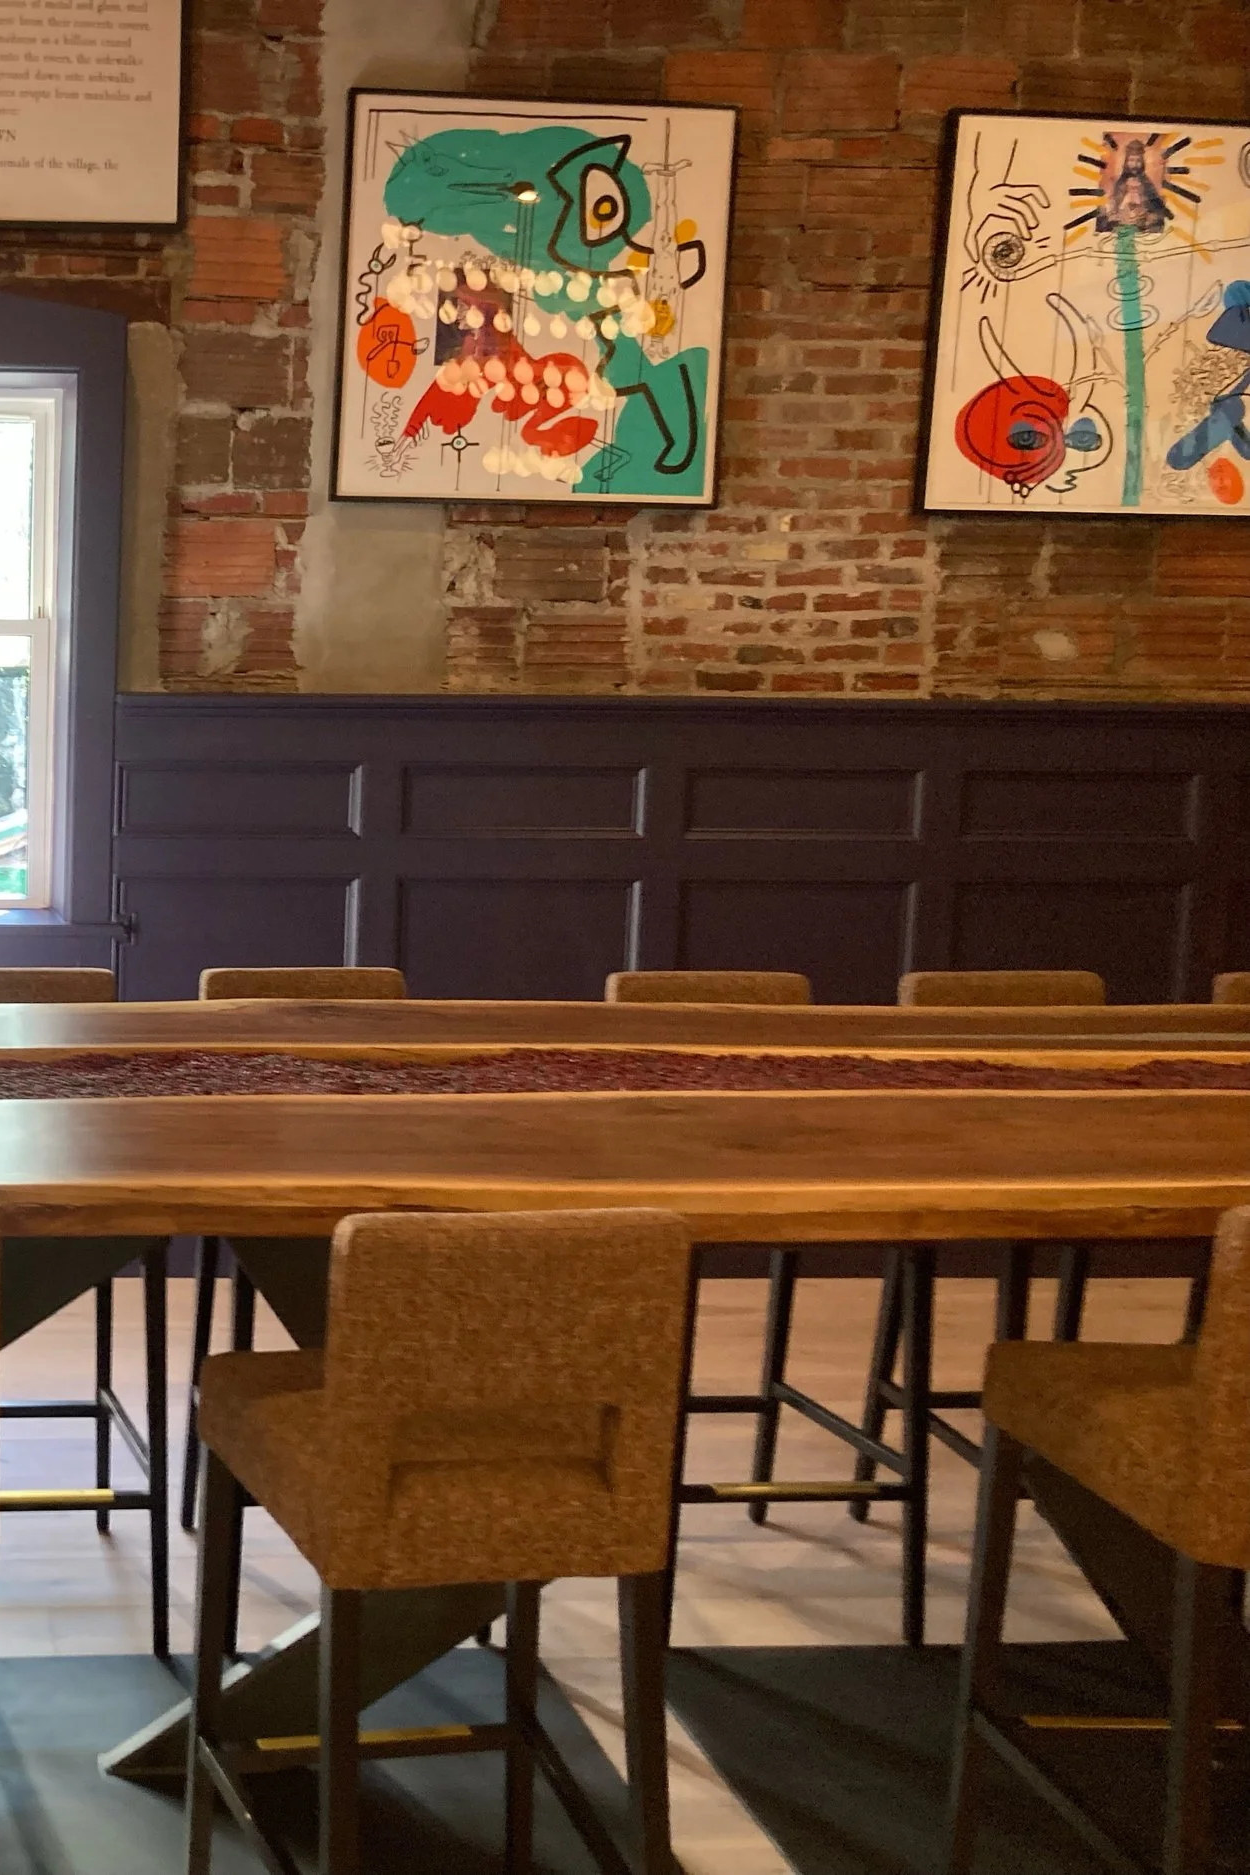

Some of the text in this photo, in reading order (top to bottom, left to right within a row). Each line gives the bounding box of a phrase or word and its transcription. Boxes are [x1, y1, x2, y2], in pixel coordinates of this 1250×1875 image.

[24, 51, 40, 62] the
[76, 53, 91, 65] the
[35, 69, 61, 82] down
[134, 91, 152, 102] and
[34, 156, 45, 168] of
[49, 156, 63, 169] the
[104, 159, 119, 171] the
